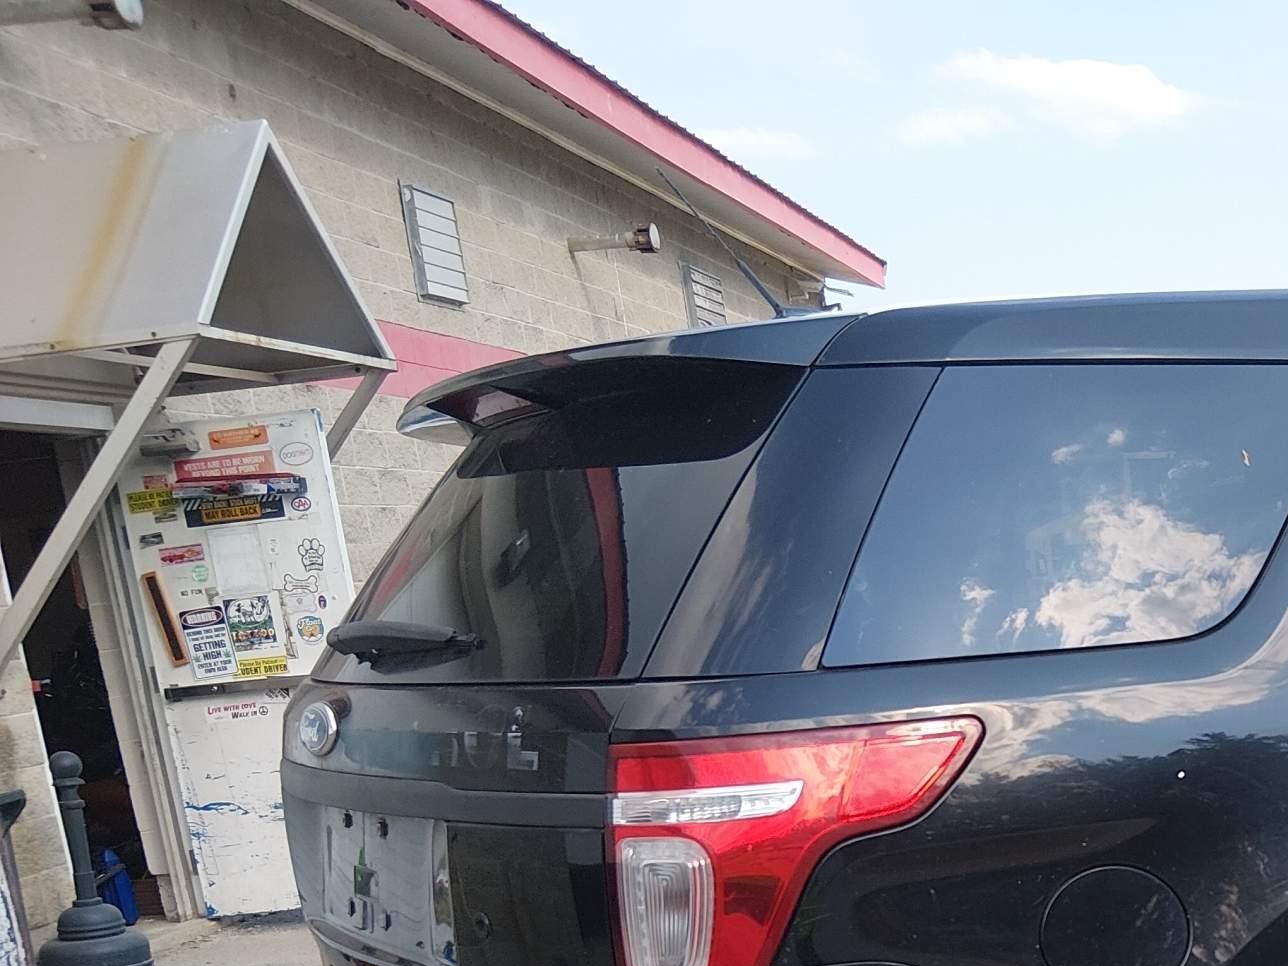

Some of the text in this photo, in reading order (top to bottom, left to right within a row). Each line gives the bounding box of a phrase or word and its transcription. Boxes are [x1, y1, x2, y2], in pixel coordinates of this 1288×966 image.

[204, 505, 258, 519] MAY ROLL BACK
[193, 640, 226, 652] GETTING
[203, 650, 222, 661] HIGH
[264, 663, 288, 674] DRIVER
